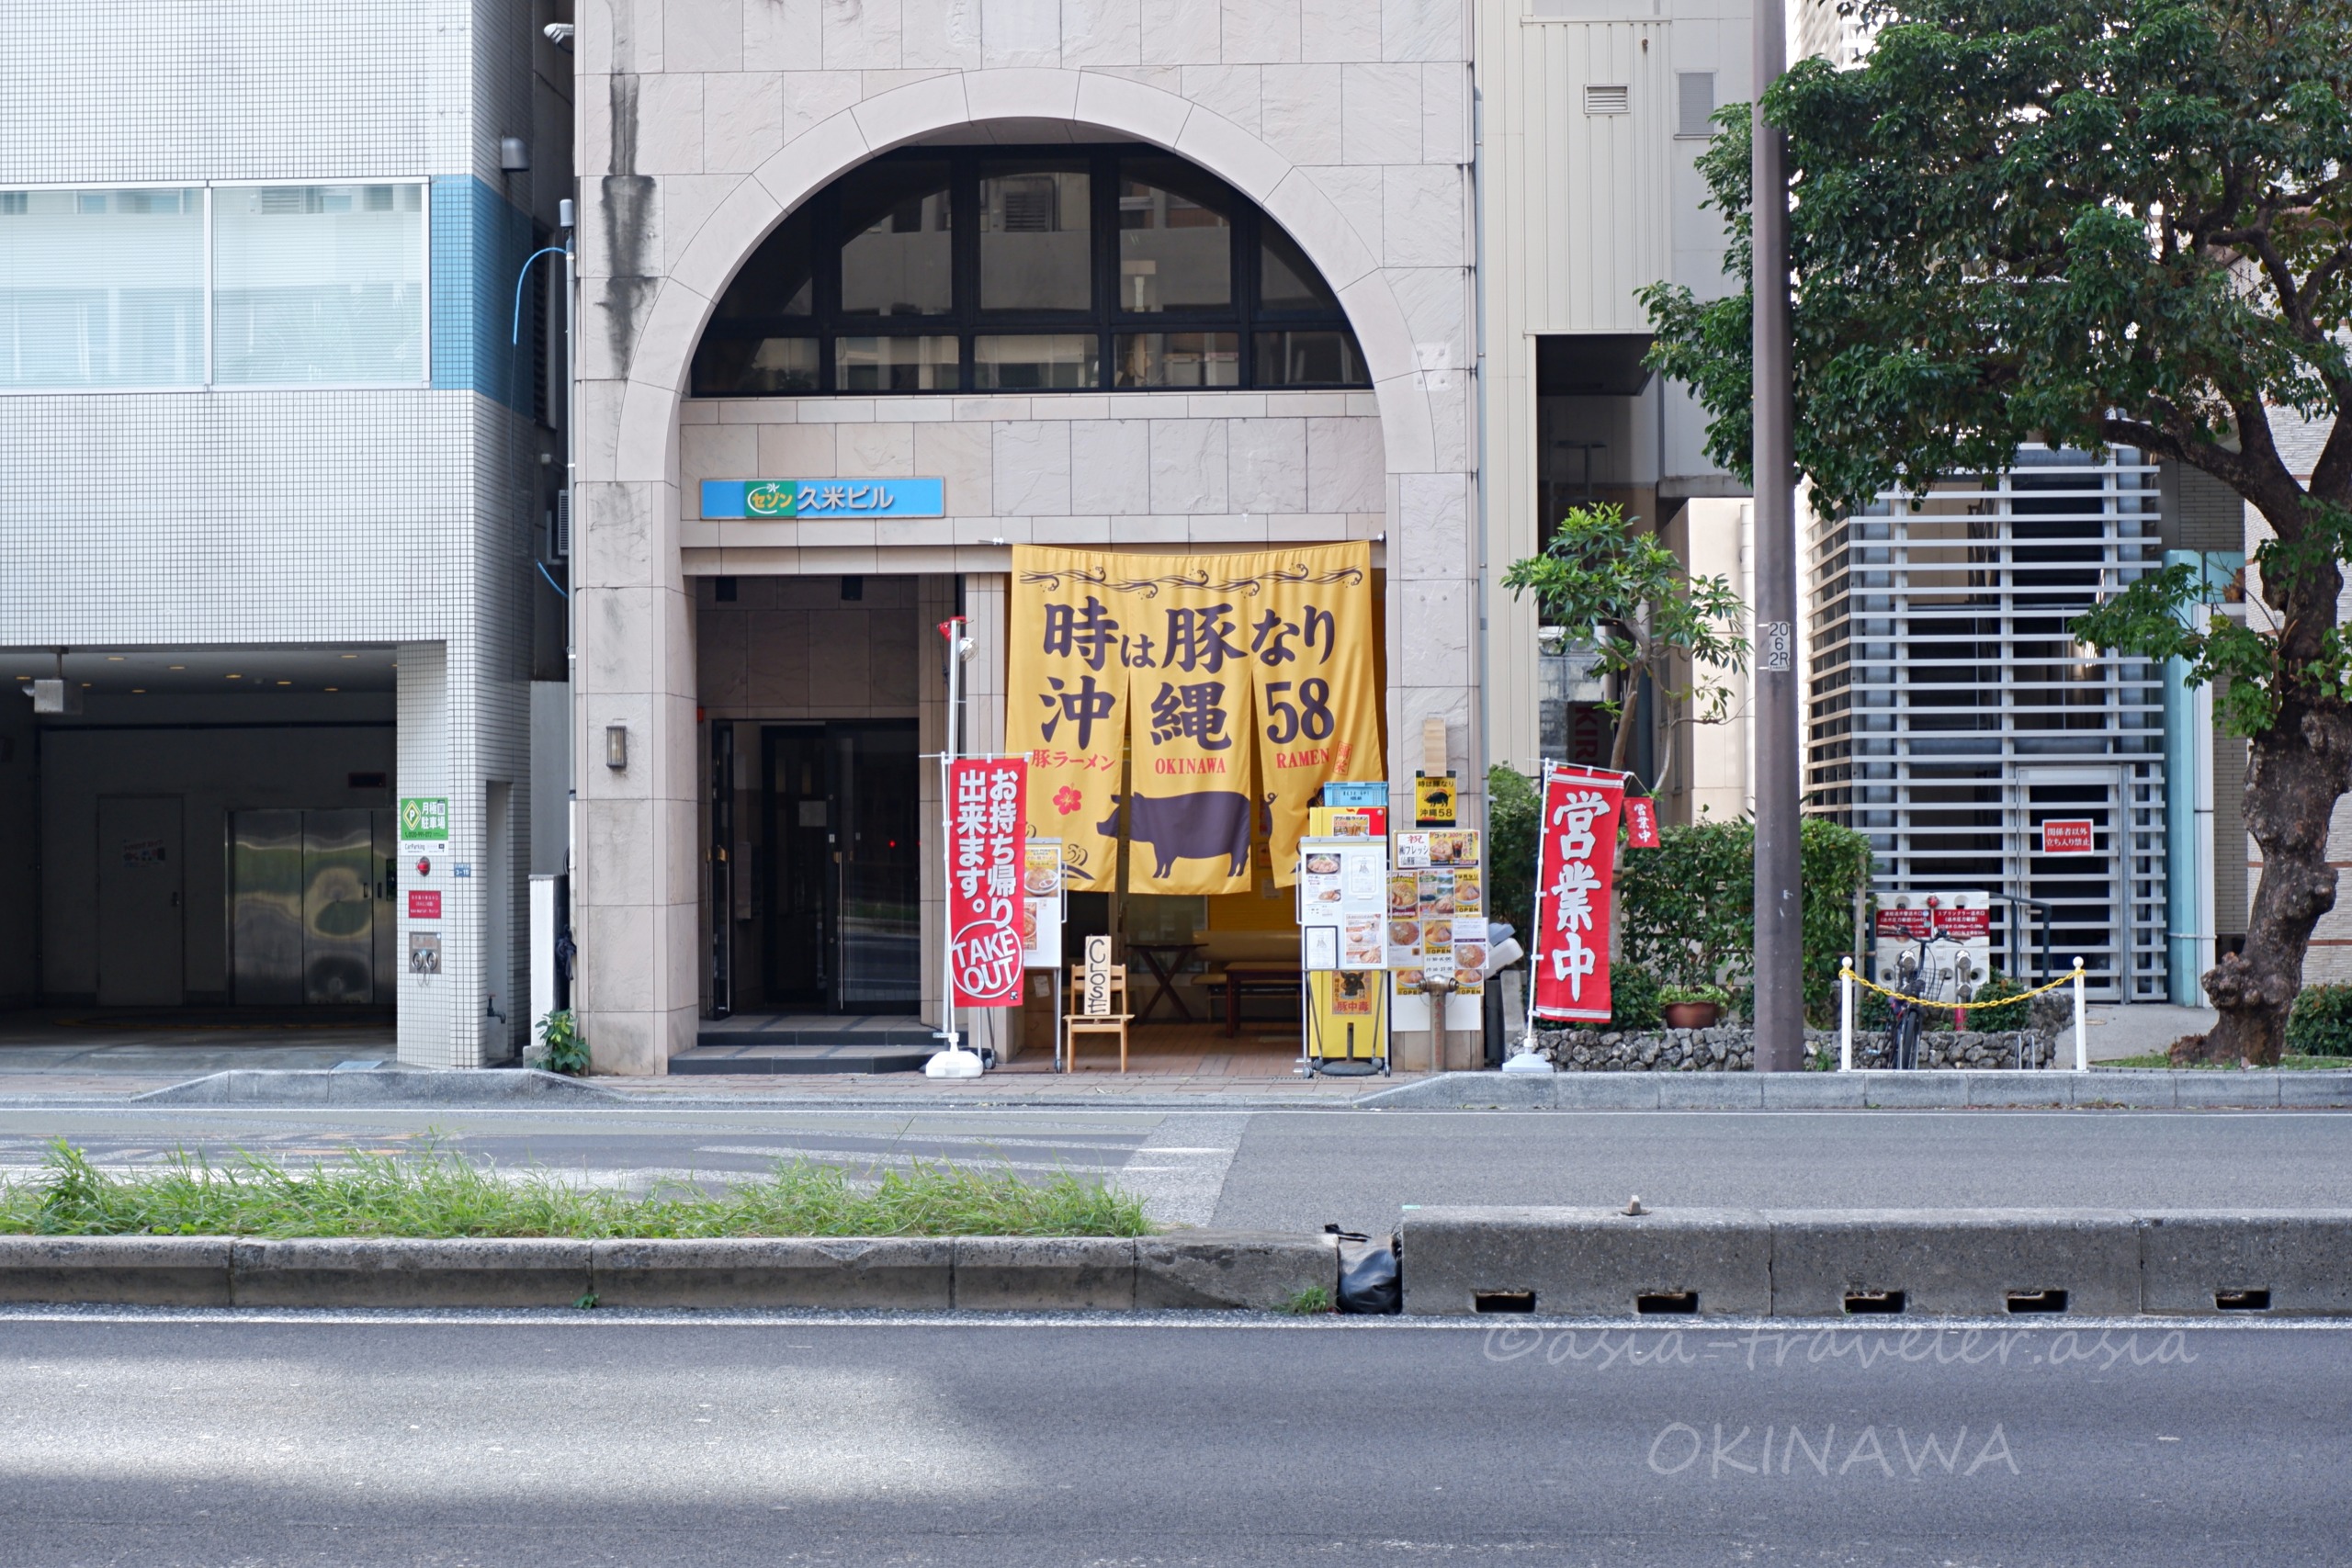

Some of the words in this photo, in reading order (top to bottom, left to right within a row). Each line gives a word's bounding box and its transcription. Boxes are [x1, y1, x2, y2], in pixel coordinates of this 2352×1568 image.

[752, 491, 793, 508] セゾン
[797, 485, 894, 511] 久米ビル
[1043, 595, 1336, 674] 時は豚なり
[1770, 622, 1789, 637] 20
[1774, 637, 1784, 651] 6
[1770, 651, 1789, 666] 2R
[1031, 749, 1116, 773] 豚ラーメン
[1154, 758, 1227, 775] OKINAWA
[1276, 748, 1330, 769] RAMEN
[1419, 808, 1453, 818] 沖縄58
[1634, 803, 1652, 843] 営業中
[956, 769, 988, 914] 出来ます。
[1408, 834, 1424, 844] 祝
[2046, 837, 2090, 847] 立ち入り禁止
[2047, 828, 2087, 836] 関係者以外
[987, 768, 1019, 929] お持ち帰り
[1552, 789, 1611, 1002] 営業中
[950, 927, 1016, 968] TAKE
[964, 957, 1014, 995] OUT
[1088, 938, 1108, 1015] CLOSE
[1337, 1001, 1369, 1012] 豚中毒
